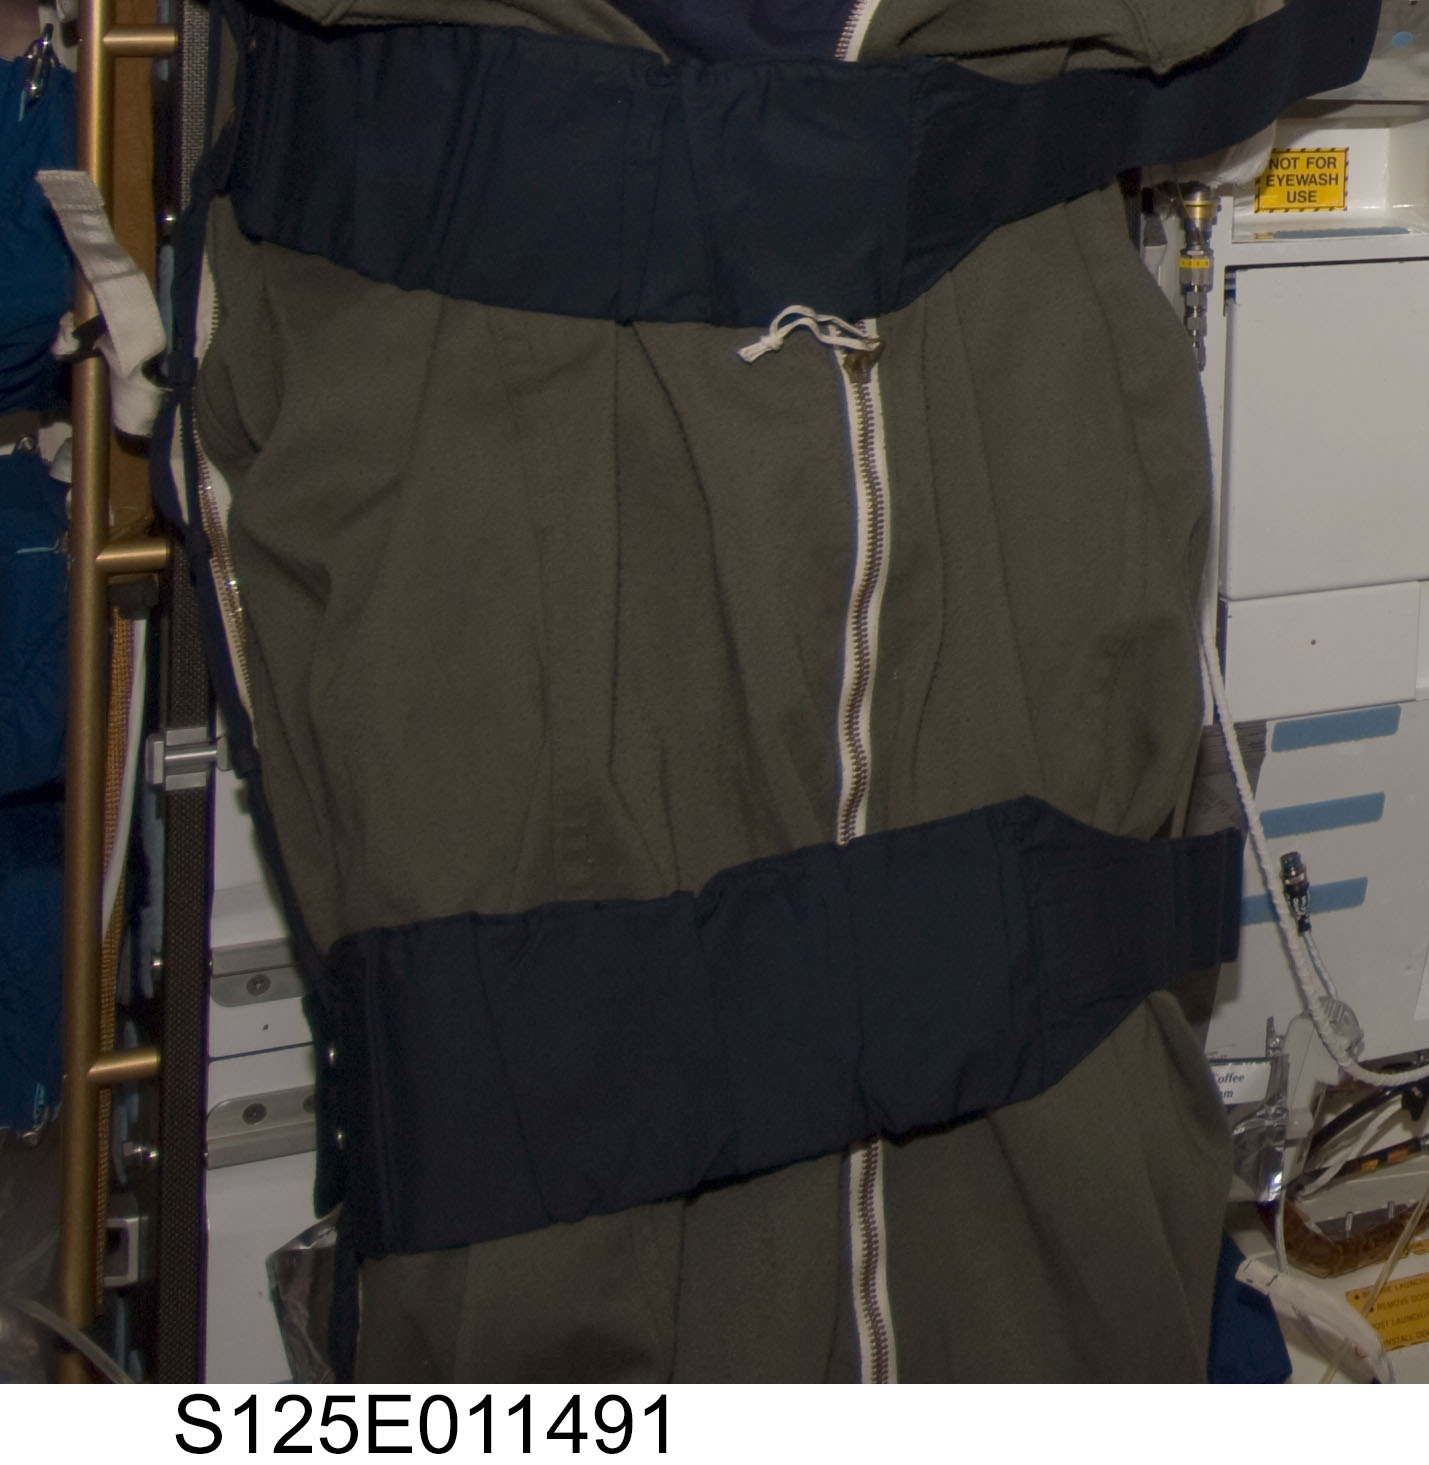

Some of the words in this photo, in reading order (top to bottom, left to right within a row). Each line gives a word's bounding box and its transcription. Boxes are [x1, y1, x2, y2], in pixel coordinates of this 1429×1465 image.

[1269, 156, 1300, 170] NOT
[1306, 156, 1337, 169] FOR
[1266, 173, 1339, 187] EYEWASH
[1286, 189, 1317, 204] USE
[1377, 1297, 1410, 1312] REMOVE
